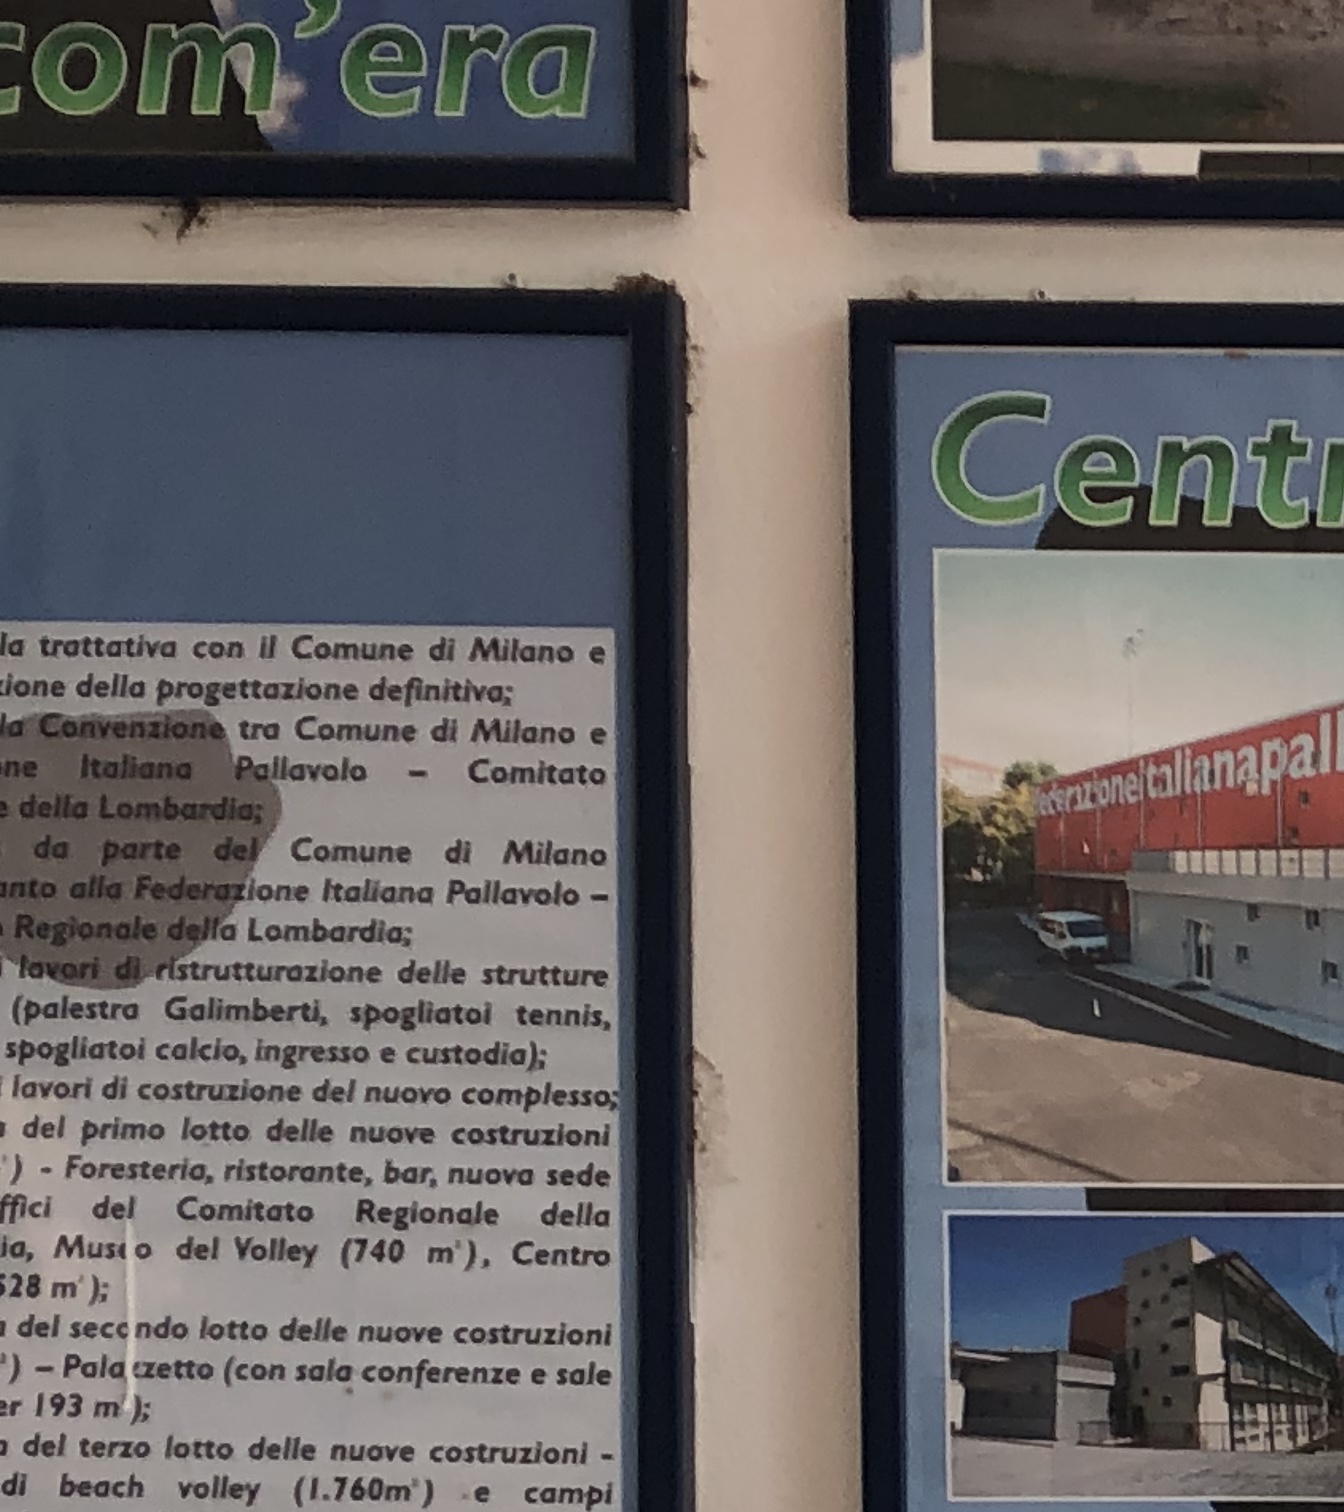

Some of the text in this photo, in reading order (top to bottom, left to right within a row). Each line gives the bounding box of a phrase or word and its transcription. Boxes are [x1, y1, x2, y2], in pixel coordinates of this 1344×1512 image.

[39, 634, 177, 658] trattativa
[193, 640, 245, 658] con
[259, 633, 277, 658] il
[291, 634, 414, 660] Comune
[429, 635, 455, 659] di
[468, 634, 574, 661] Milano
[589, 644, 605, 662] e
[76, 672, 145, 698] della
[156, 676, 359, 706] progettazione
[369, 674, 514, 706] definitiva;
[40, 711, 226, 740] Convenzione
[239, 719, 280, 739] tra
[295, 715, 417, 741] Comune
[430, 716, 458, 741] di
[470, 717, 575, 741] Milano
[590, 724, 607, 743] e
[81, 753, 192, 779] Italiana
[229, 753, 368, 782] Pallavolo
[468, 756, 606, 783] Comitato
[20, 793, 88, 819] della
[99, 794, 264, 825] Lombardia;
[34, 834, 607, 867] da parte del Comune di Milano
[70, 874, 122, 899] alla
[135, 873, 309, 902] Federazione
[322, 876, 434, 903] Italiana
[446, 877, 580, 904] Pallavolo
[14, 914, 157, 947] Regionale
[167, 914, 236, 943] della
[248, 916, 413, 946] Lombardia;
[20, 954, 99, 982] lavori
[116, 956, 141, 982] di
[156, 954, 382, 982] ristrutturazione
[398, 957, 466, 983] delle
[481, 963, 608, 985] strutture
[12, 995, 611, 1031] (palestra Galimberti, spogliatoi tennis,
[5, 1035, 547, 1071] spogliatoi calcio, ingresso e custodia);
[12, 1074, 92, 1100] lavori
[102, 1075, 128, 1099] di
[137, 1077, 302, 1103] costruzione
[312, 1077, 356, 1102] del
[364, 1085, 451, 1103] nuovo
[462, 1079, 618, 1111] complesso;
[22, 1114, 65, 1139] del
[81, 1116, 165, 1147] primo
[181, 1116, 250, 1141] lotto
[266, 1116, 334, 1142] delle
[350, 1124, 436, 1143] nuove
[451, 1120, 610, 1144] costruzioni
[65, 1155, 214, 1185] Foresteria,
[224, 1157, 373, 1186] ristorante,
[383, 1157, 437, 1187] bar,
[448, 1166, 534, 1184] nuova
[546, 1160, 611, 1185] sede
[92, 1195, 136, 1219] del
[176, 1195, 315, 1221] Comitato
[356, 1197, 499, 1230] Regionale
[540, 1199, 610, 1225] della
[176, 1235, 220, 1260] del
[234, 1235, 318, 1267] Volley
[341, 1236, 405, 1269] (740
[512, 1239, 610, 1264] Centro
[16, 1313, 60, 1338] del
[200, 1315, 268, 1341] lotto
[279, 1315, 347, 1341] delle
[358, 1324, 443, 1341] nuove
[453, 1319, 612, 1343] costruzioni
[224, 1354, 286, 1387] (con
[295, 1356, 353, 1383] sala
[361, 1357, 520, 1388] conferenze
[531, 1365, 547, 1383] e
[556, 1359, 612, 1383] sale
[35, 1392, 83, 1418] 193
[23, 1432, 67, 1458] del
[79, 1438, 151, 1458] terzo
[165, 1434, 234, 1460] lotto
[248, 1435, 316, 1460] delle
[330, 1443, 415, 1461] nuove
[429, 1438, 588, 1462] costruzioni
[1, 1471, 27, 1496] di
[60, 1473, 144, 1499] beach
[178, 1474, 261, 1506] volley
[474, 1484, 490, 1502] e
[524, 1478, 613, 1510] campi
